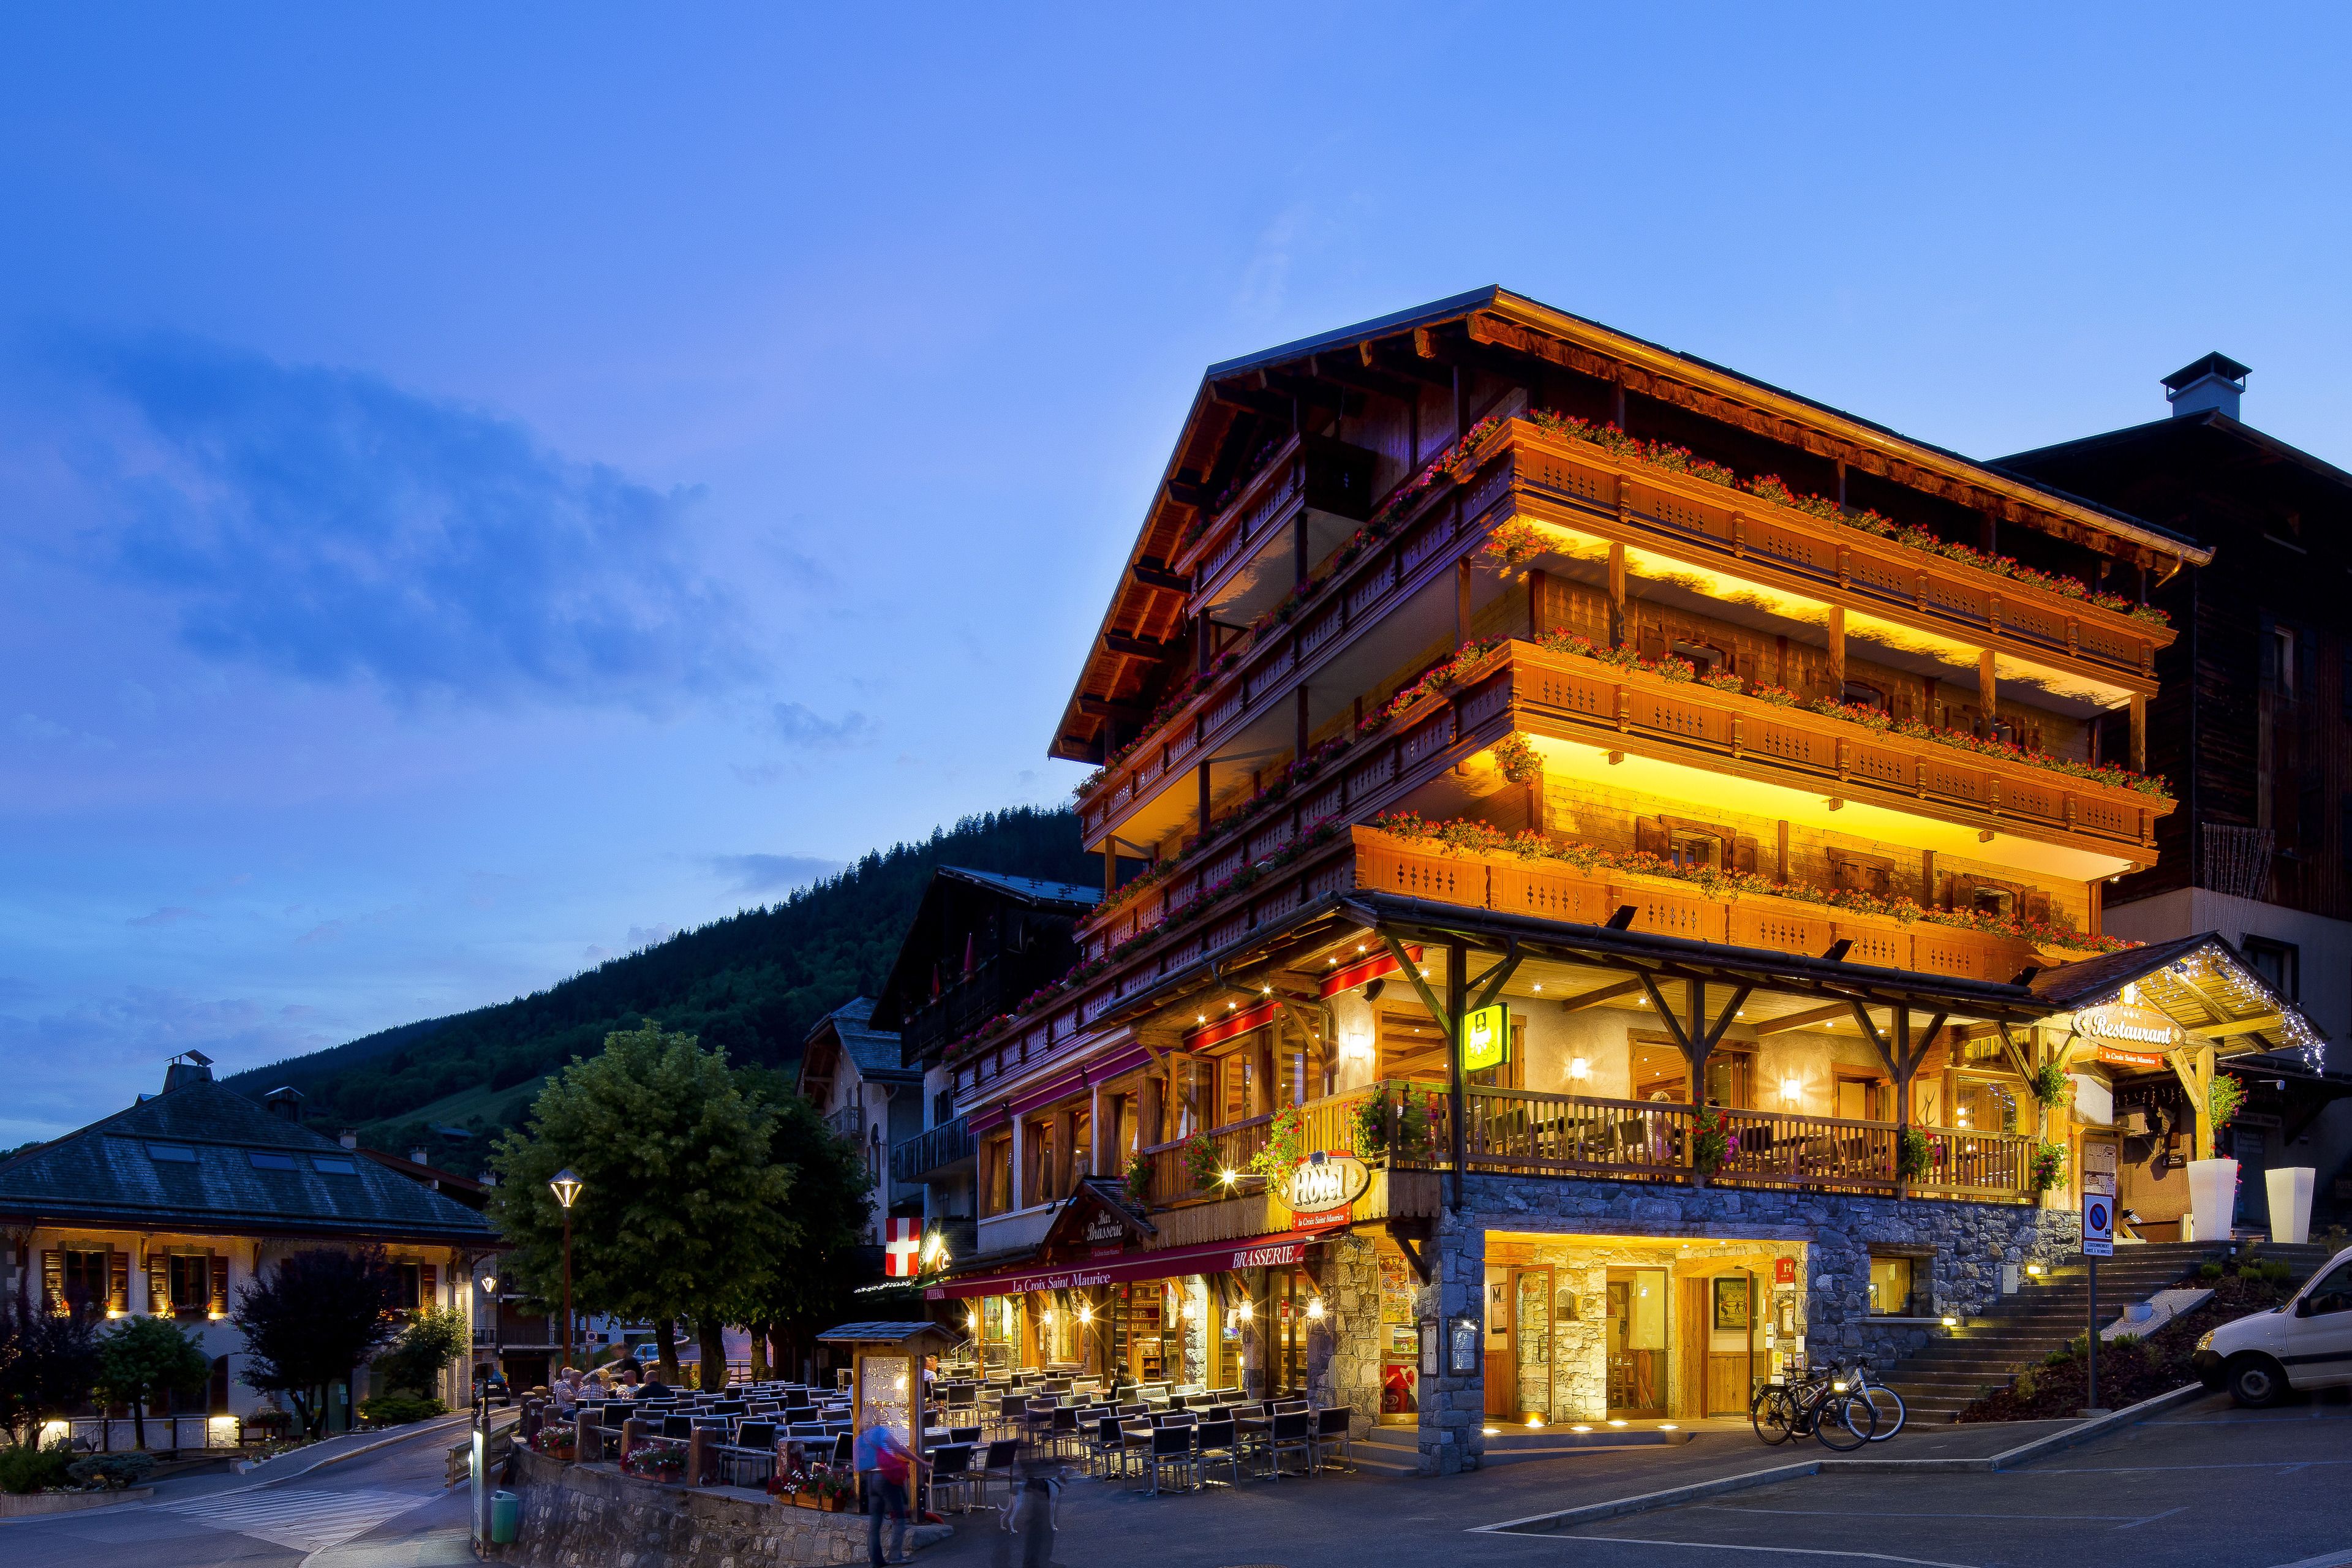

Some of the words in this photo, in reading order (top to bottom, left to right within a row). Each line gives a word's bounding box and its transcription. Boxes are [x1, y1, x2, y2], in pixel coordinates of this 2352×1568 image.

[2092, 1014, 2172, 1046] Restaurant
[2111, 1052, 2124, 1061] Croix
[2137, 1055, 2156, 1065] Maurice
[1294, 1165, 1346, 1206] Hôtel
[1098, 1210, 1111, 1225] Bar
[1303, 1216, 1315, 1226] Croix
[1315, 1215, 1326, 1224] Saint
[1326, 1213, 1344, 1223] Maurice
[1087, 1220, 1123, 1241] Brasserie
[1232, 1245, 1294, 1268] BRASSERIE
[1784, 1263, 1792, 1273] H
[1012, 1280, 1022, 1292] La
[1025, 1278, 1046, 1292] Croix
[1048, 1276, 1068, 1290] Saint
[1071, 1272, 1110, 1287] Maurice
[927, 1288, 945, 1300] PIZZERIA
